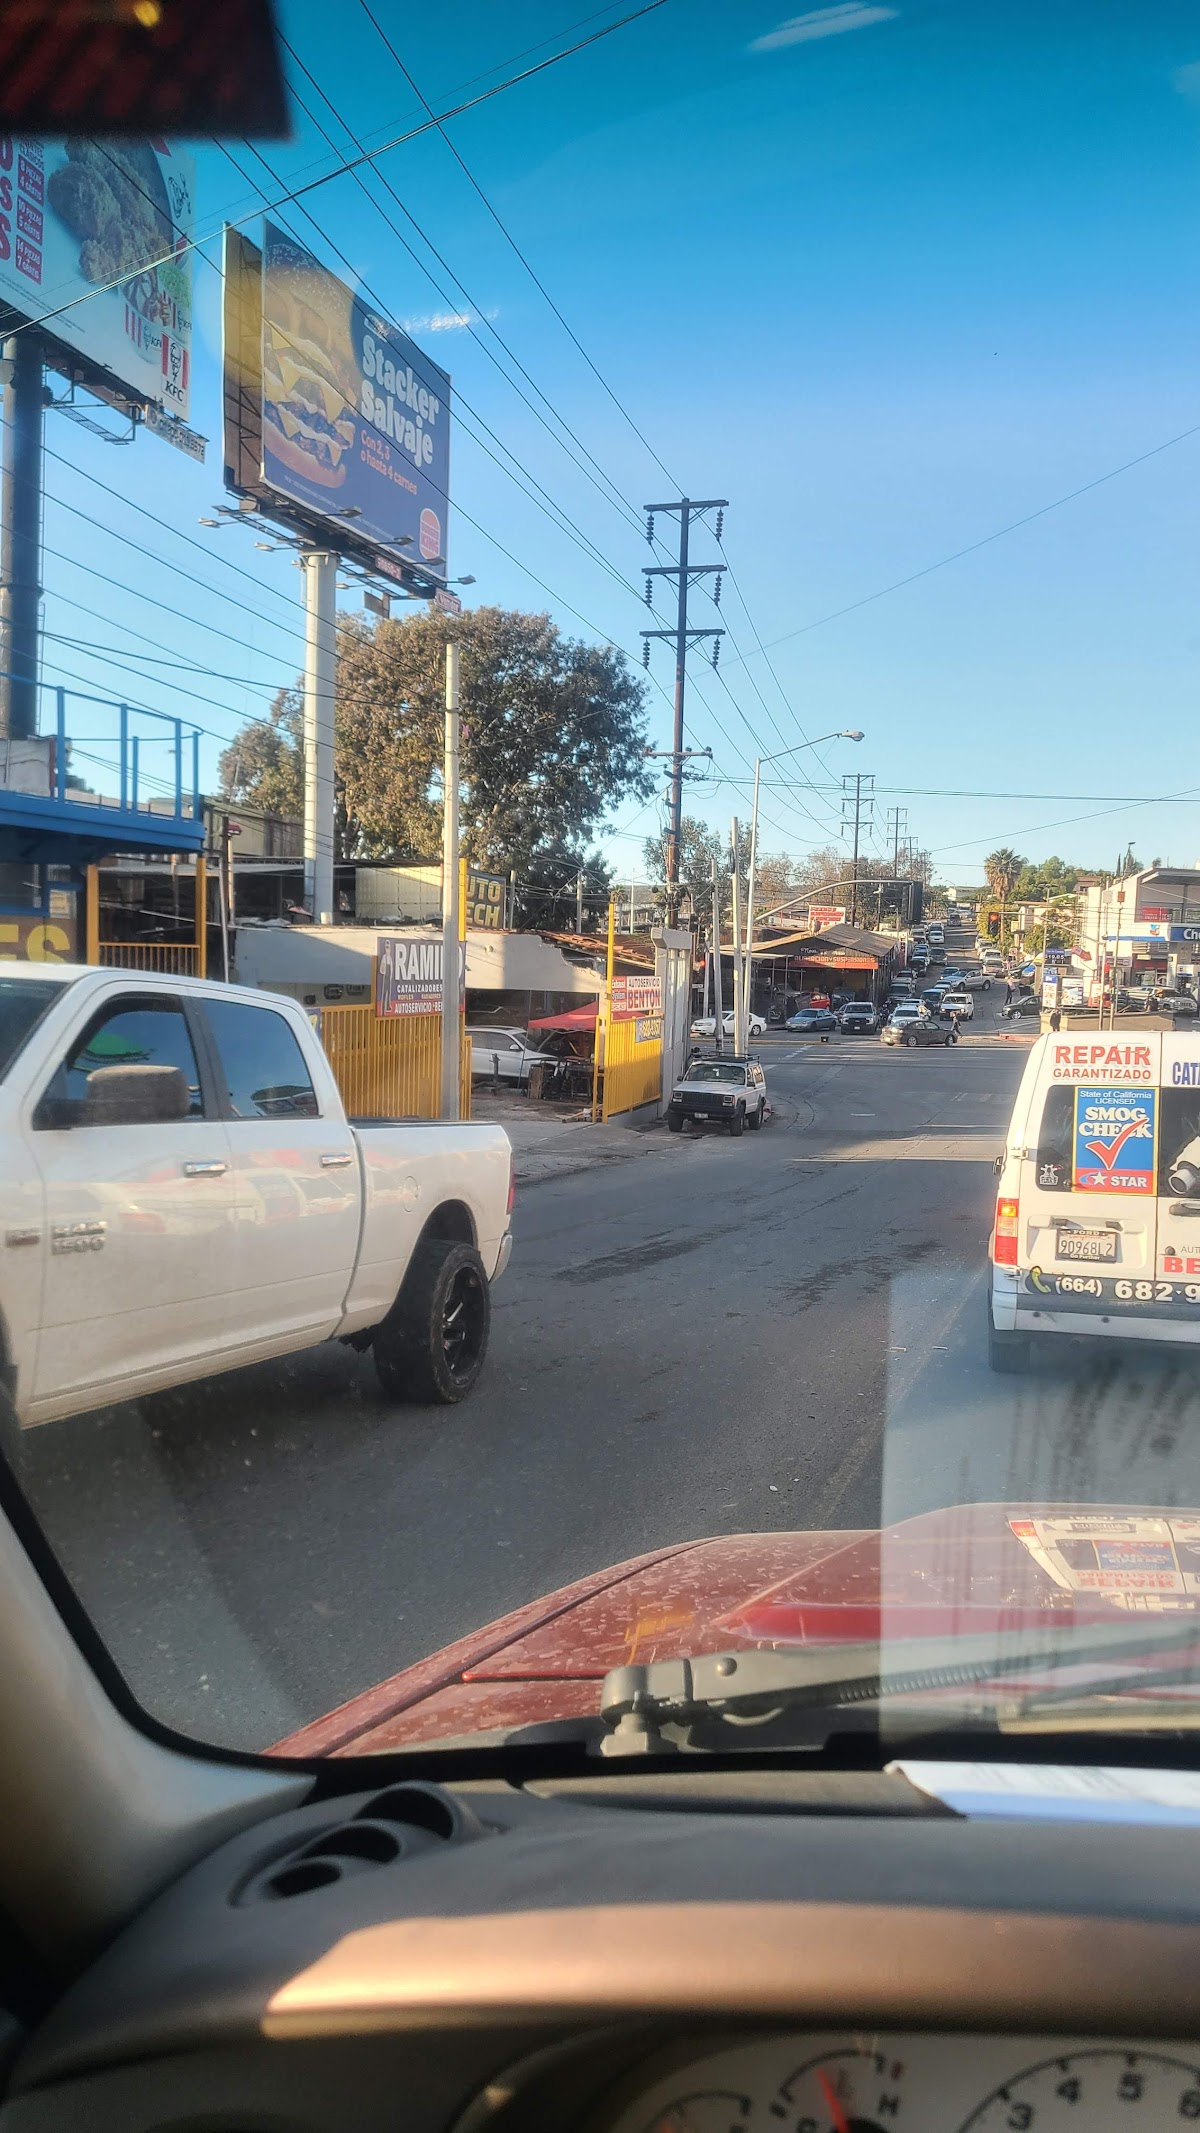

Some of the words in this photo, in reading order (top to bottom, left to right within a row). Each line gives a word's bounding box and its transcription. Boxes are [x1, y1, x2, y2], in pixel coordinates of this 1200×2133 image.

[362, 334, 440, 426] Stacker
[165, 380, 184, 402] KFC
[361, 379, 433, 468] Salvaje
[361, 430, 376, 451] Con
[366, 450, 388, 476] hasta
[393, 470, 418, 496] carnes
[466, 875, 501, 902] UTO
[466, 901, 500, 928] ECH
[1183, 929, 1200, 940] Ch
[394, 943, 463, 981] RAMI
[396, 984, 443, 994] CATALIZADORES
[629, 978, 660, 988] AUTOSERVICIO
[394, 1002, 432, 1014] AUTOSERVICIO
[628, 989, 661, 1009] BENTON
[1055, 1045, 1151, 1066] REPAIR
[1053, 1068, 1151, 1080] GARANTIZADO
[1172, 1061, 1200, 1086] CAT
[1080, 1090, 1102, 1098] State
[1103, 1090, 1112, 1098] of
[1113, 1091, 1152, 1099] California
[1085, 1106, 1148, 1122] SMOG
[1110, 1176, 1148, 1187] STAR
[1056, 1277, 1103, 1297] (664)
[1055, 2076, 1081, 2106] 4
[1118, 2073, 1144, 2102] 5
[1008, 2102, 1034, 2131] 3
